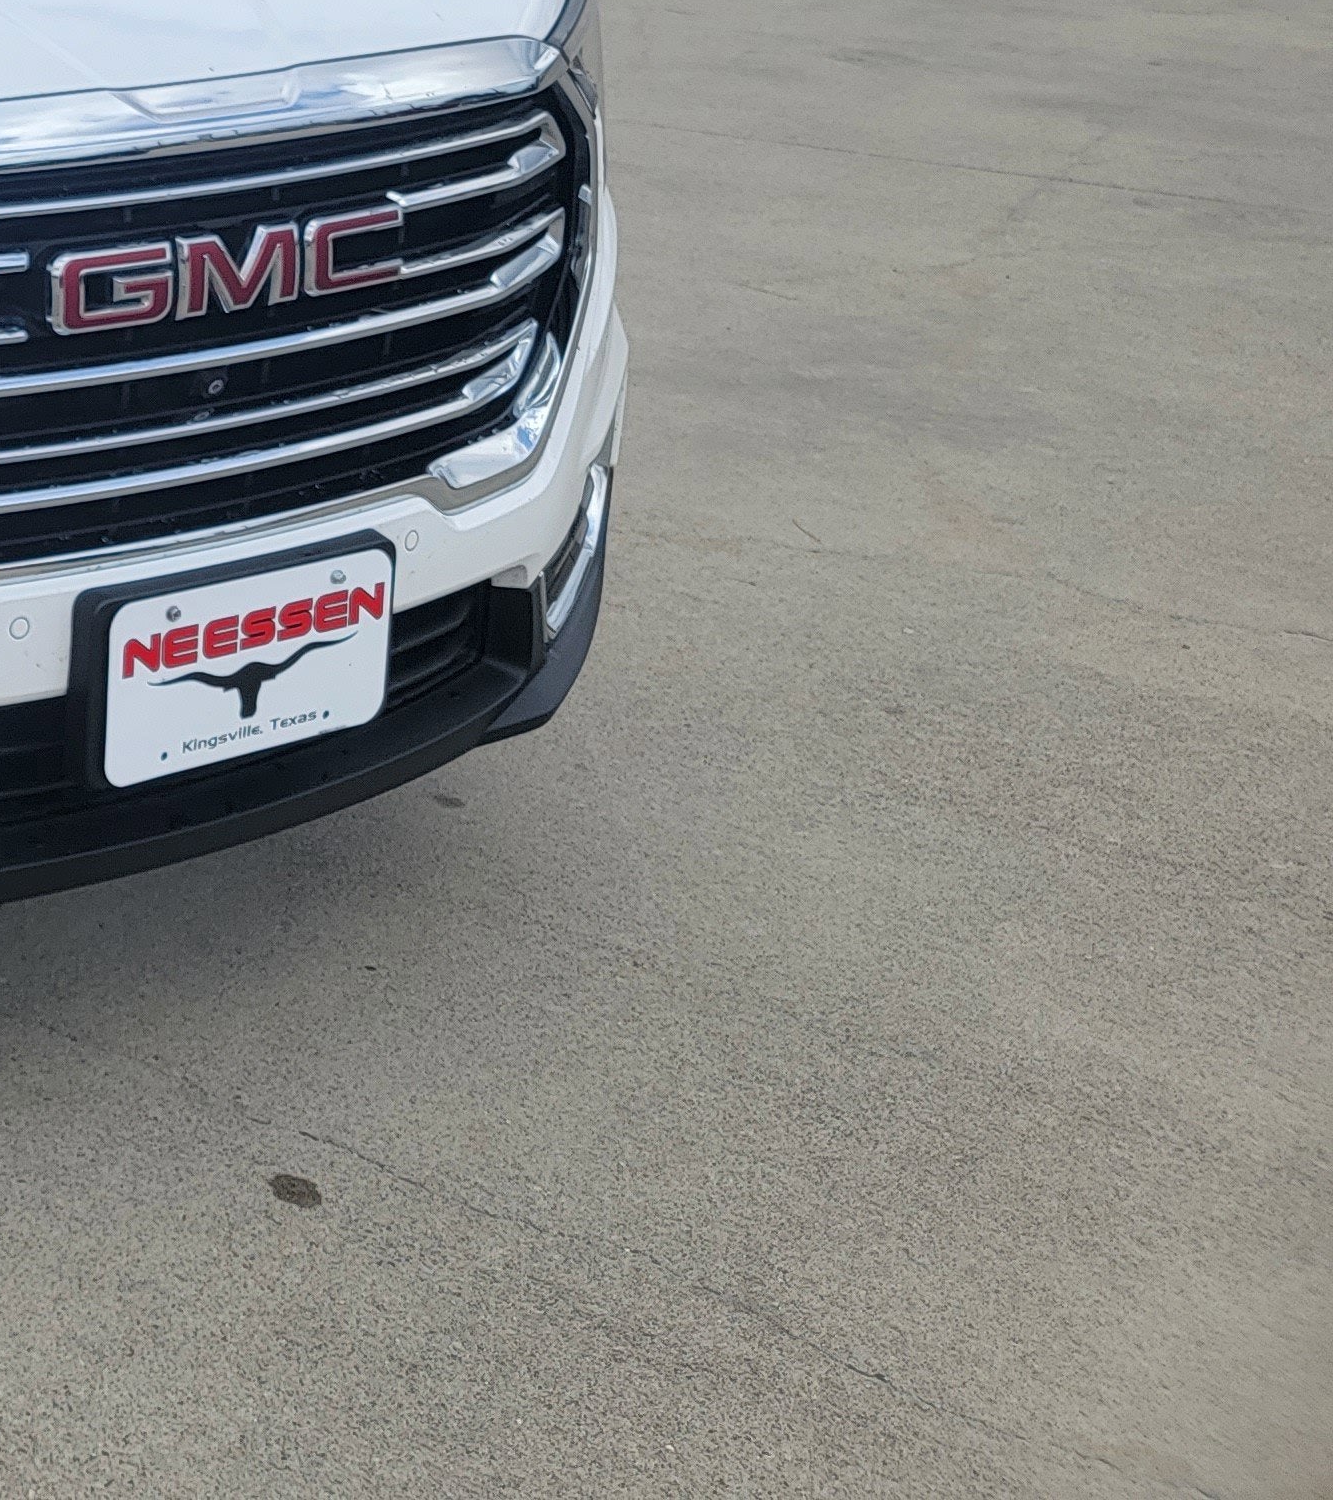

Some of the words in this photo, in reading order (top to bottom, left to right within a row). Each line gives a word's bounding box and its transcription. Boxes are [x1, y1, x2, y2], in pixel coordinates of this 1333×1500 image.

[46, 204, 404, 336] GMC
[121, 581, 385, 680] NEESSEN
[269, 709, 317, 731] Texas
